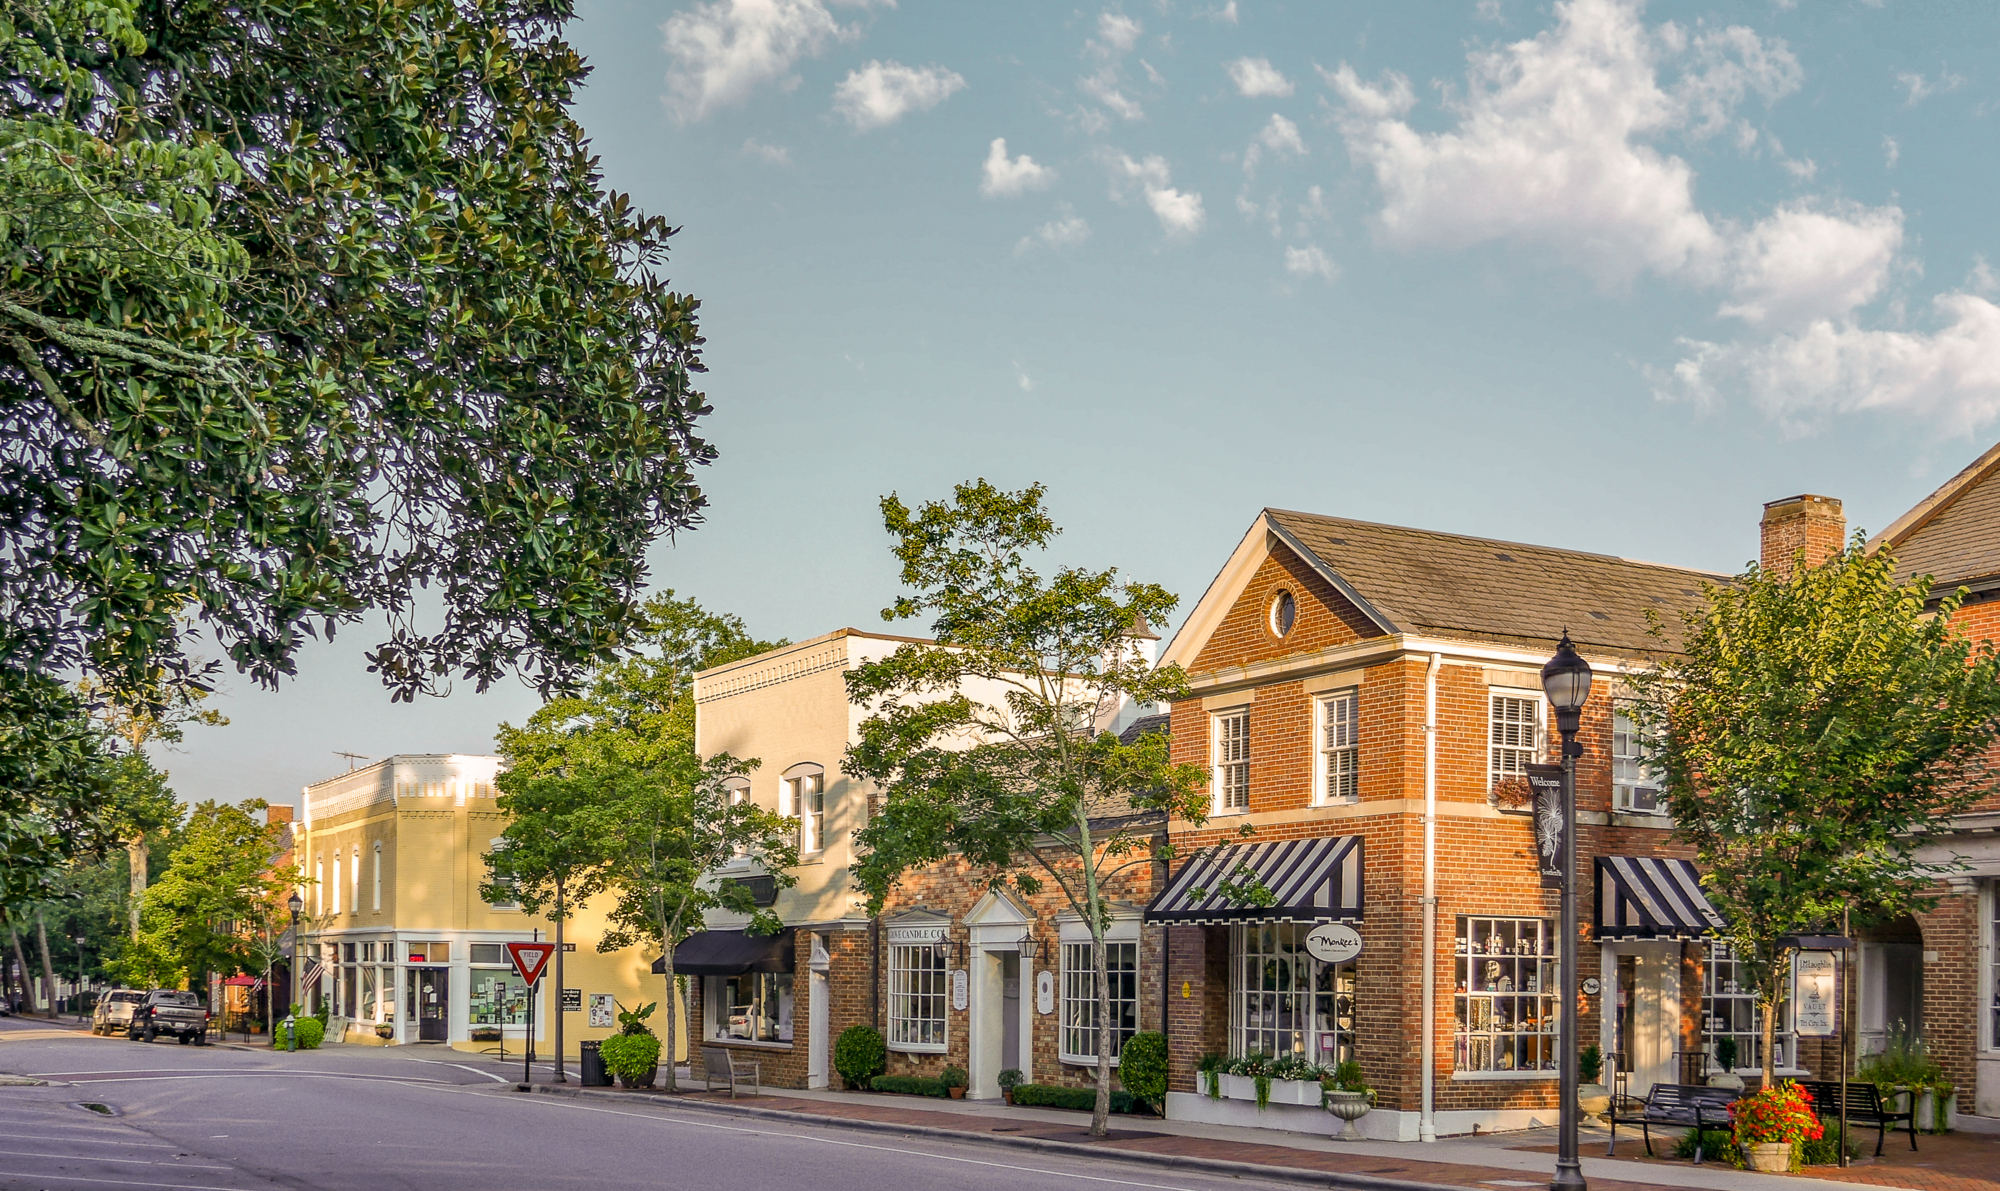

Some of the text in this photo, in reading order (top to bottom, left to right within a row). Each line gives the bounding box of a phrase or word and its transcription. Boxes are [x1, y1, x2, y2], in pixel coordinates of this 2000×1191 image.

[1530, 776, 1560, 787] Welcome
[902, 929, 929, 939] CANDLE
[1310, 936, 1359, 948] Monkee's
